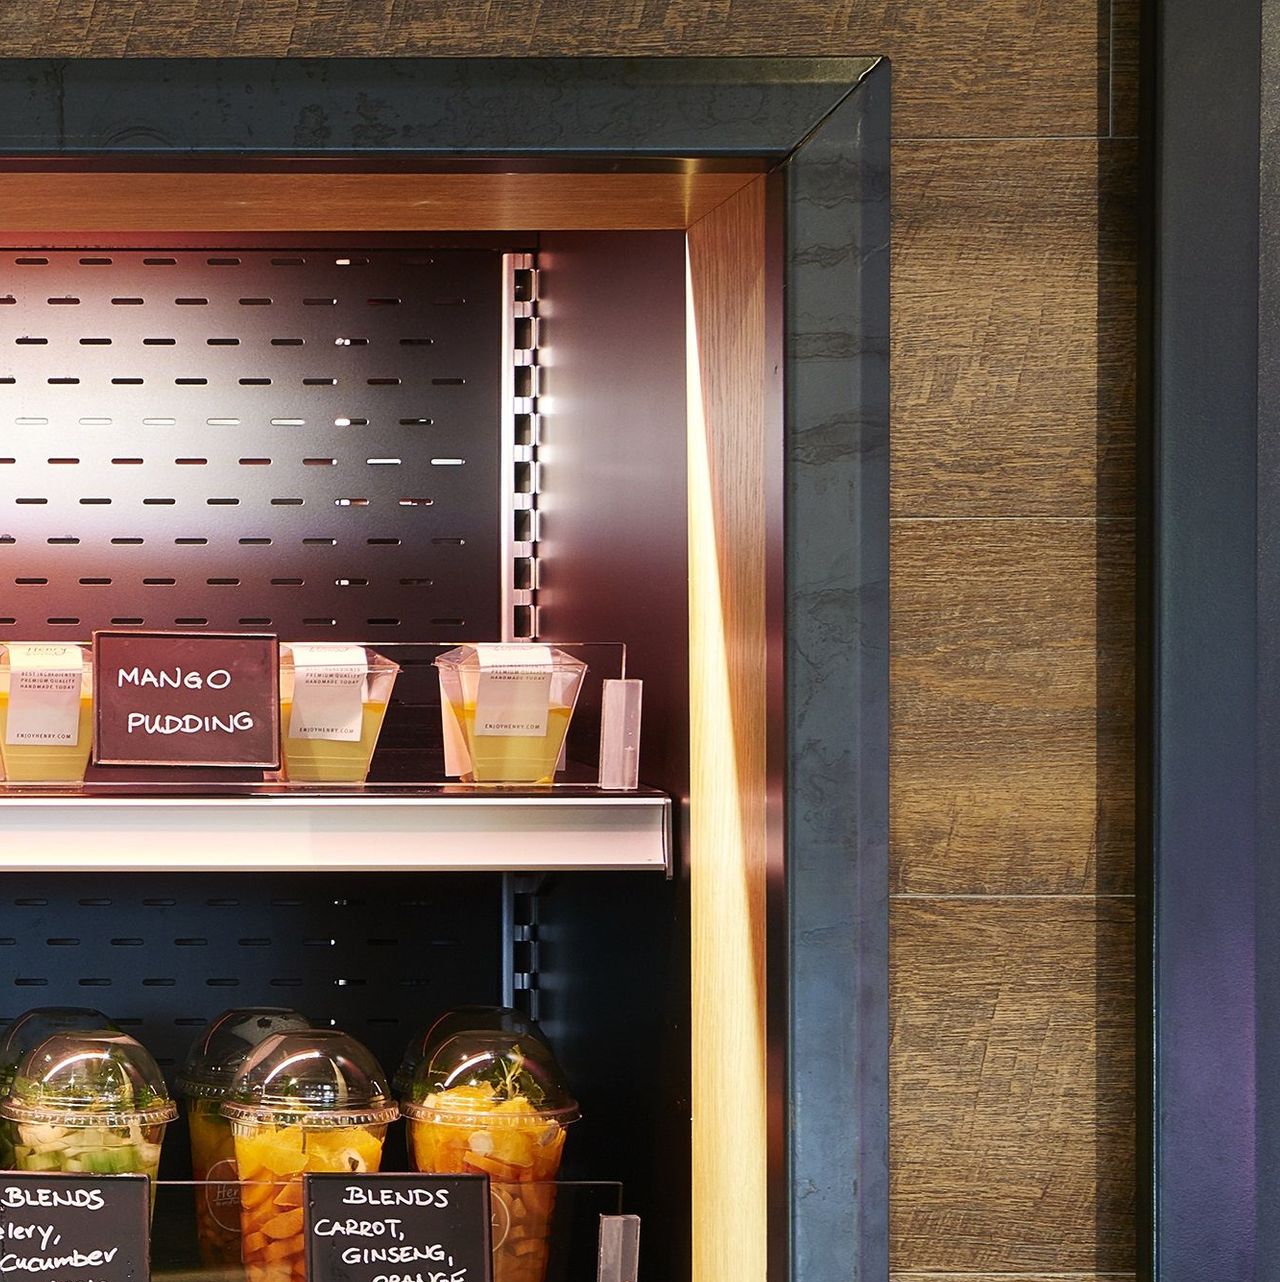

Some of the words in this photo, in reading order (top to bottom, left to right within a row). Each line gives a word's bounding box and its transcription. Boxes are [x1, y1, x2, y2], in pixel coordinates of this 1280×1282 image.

[117, 667, 232, 690] MANGO
[127, 711, 254, 735] PUDDING
[0, 1186, 106, 1210] BLENDS
[342, 1186, 450, 1209] BLENDS
[313, 1218, 406, 1242] CARROT,
[0, 1247, 119, 1273] Cucumber
[341, 1244, 455, 1267] GINSENG,
